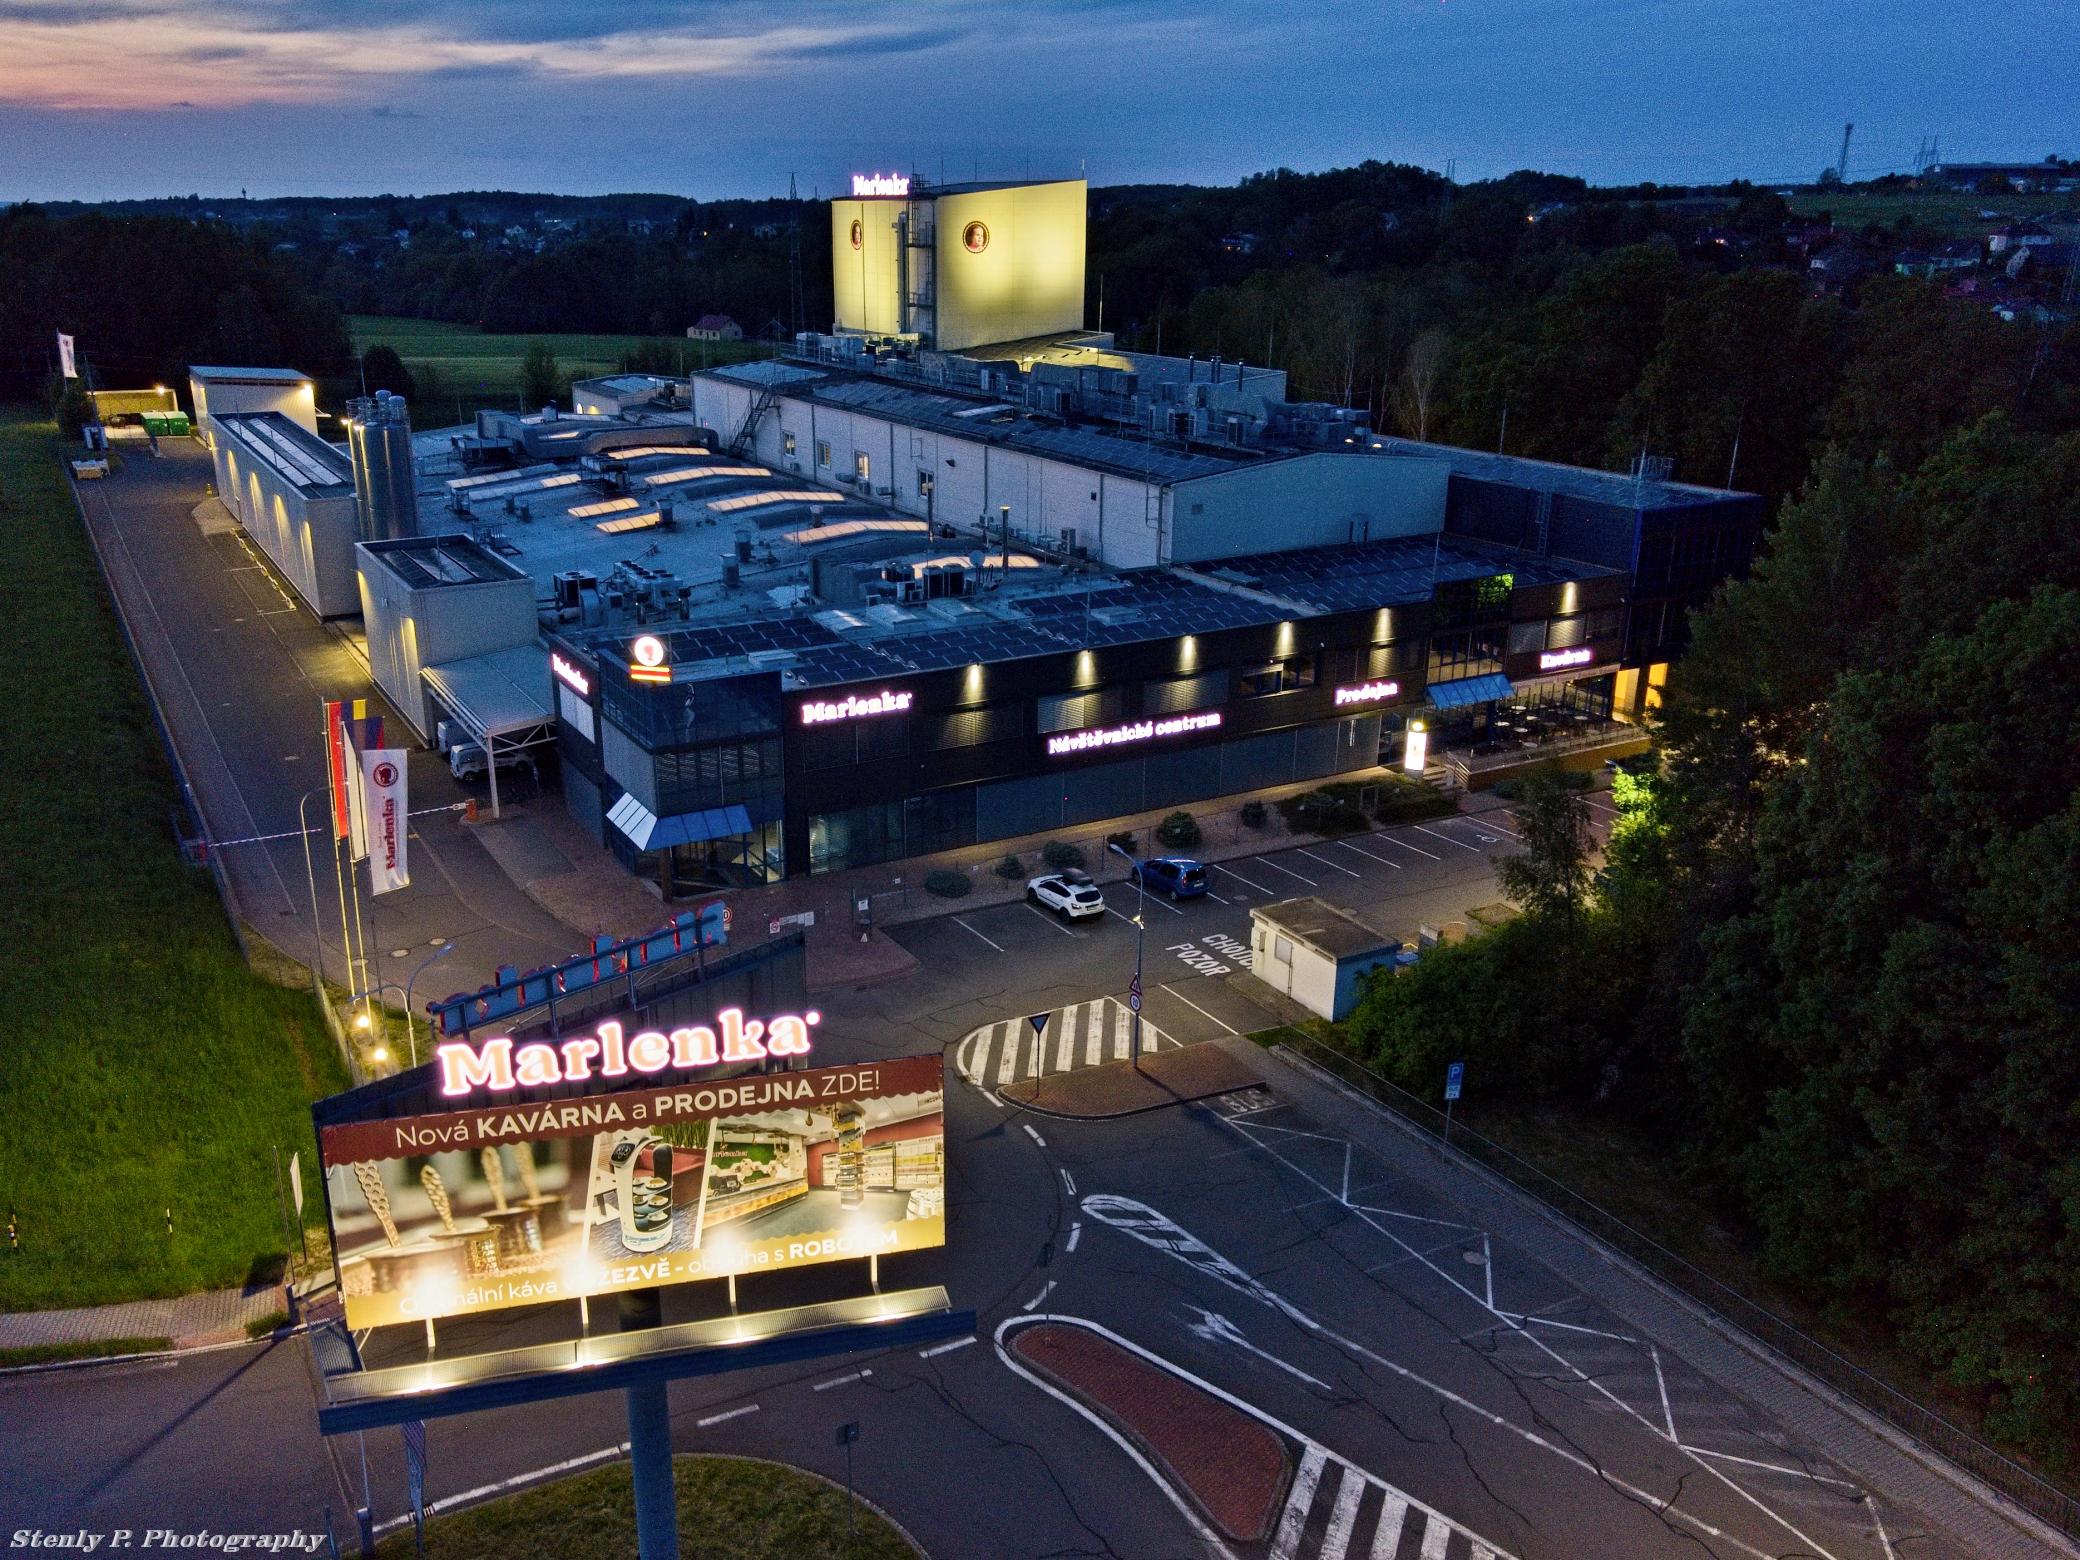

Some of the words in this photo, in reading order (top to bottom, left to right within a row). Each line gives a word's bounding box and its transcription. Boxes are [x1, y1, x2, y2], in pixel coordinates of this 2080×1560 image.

[802, 691, 913, 724] Marlenka
[1155, 713, 1221, 736] centrum
[382, 797, 396, 870] Marlenka
[1165, 942, 1232, 977] POZOR
[437, 1007, 820, 1096] Marlenka
[395, 1119, 470, 1149] Nová
[476, 1102, 627, 1139] KAVÁRNA
[632, 1103, 648, 1120] a
[654, 1078, 815, 1117] PRODEJNA
[821, 1070, 881, 1097] ZDE!
[399, 1283, 504, 1315] Onální
[508, 1279, 558, 1298] káva
[773, 1248, 785, 1262] s
[789, 1229, 899, 1260] ROBOM
